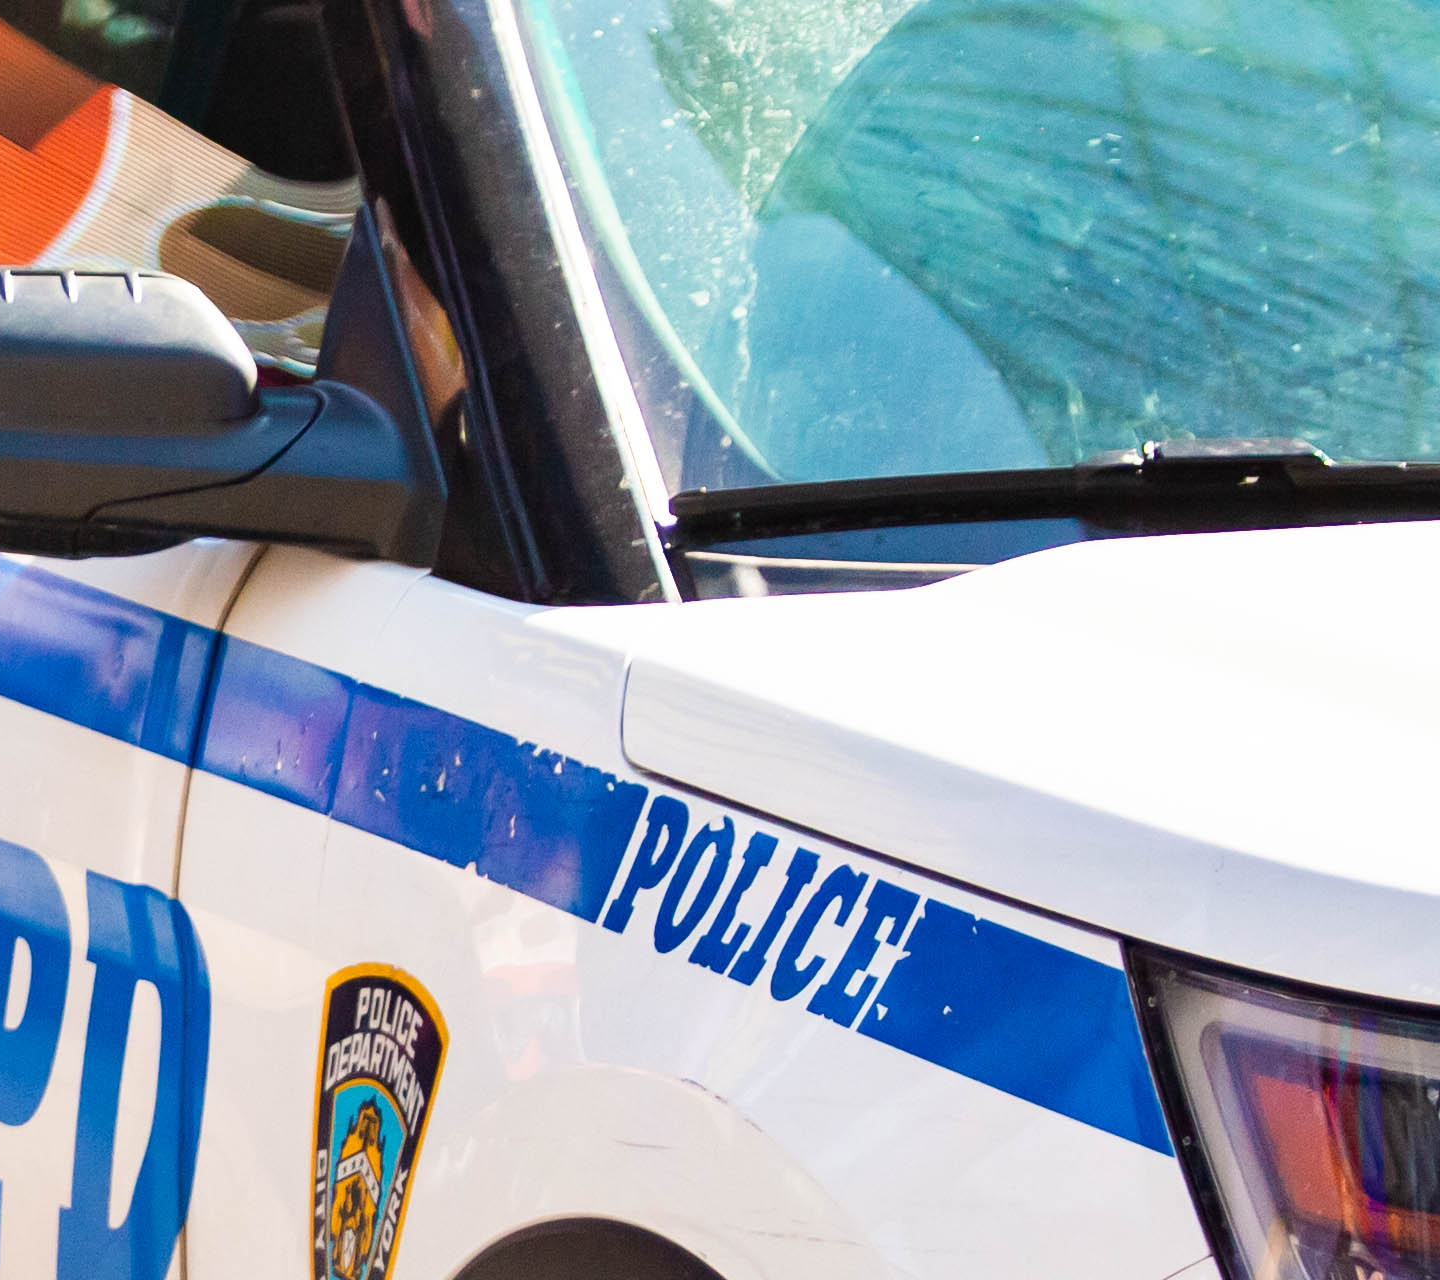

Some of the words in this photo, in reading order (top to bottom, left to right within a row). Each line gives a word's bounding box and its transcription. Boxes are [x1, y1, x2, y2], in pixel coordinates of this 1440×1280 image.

[601, 794, 921, 1029] POLICE
[354, 986, 424, 1061] POLICE
[323, 1031, 425, 1137] DEPARTMENT
[314, 1148, 329, 1251] CITY
[373, 1168, 410, 1273] YORK
